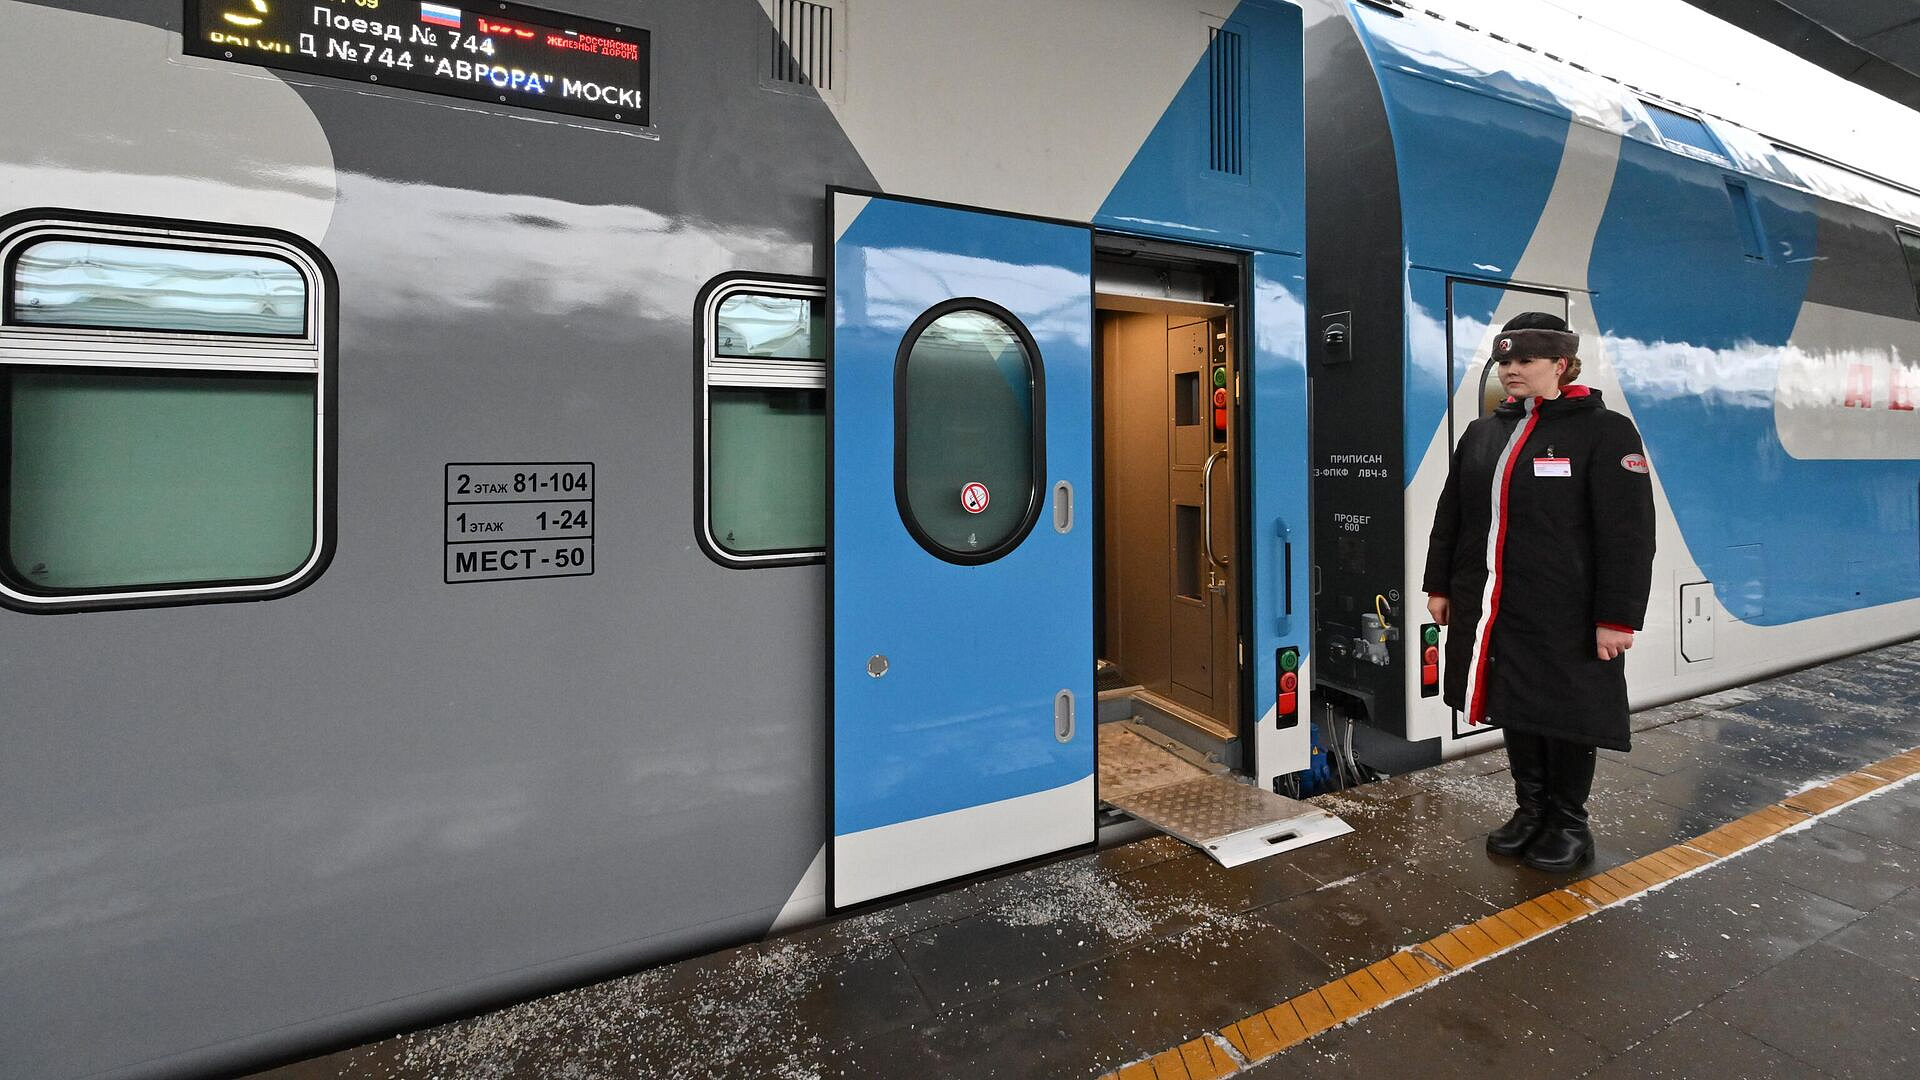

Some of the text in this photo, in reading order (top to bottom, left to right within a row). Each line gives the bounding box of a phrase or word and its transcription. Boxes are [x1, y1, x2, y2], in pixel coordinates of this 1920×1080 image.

[313, 6, 402, 43] Поезд
[409, 24, 437, 47] №
[447, 30, 495, 56] 744
[547, 35, 638, 61] ЖЕЛЕЗНЫЕ ДОРОГИ
[579, 34, 638, 53] РОССИЙСКИЕ
[1330, 454, 1382, 464] ПРИПИСАН
[457, 474, 471, 494] 2
[513, 472, 588, 493] 81-104
[1358, 468, 1388, 478] ЛВЧ-8
[456, 512, 466, 533] 1
[1334, 513, 1371, 525] ПРОБЕГ
